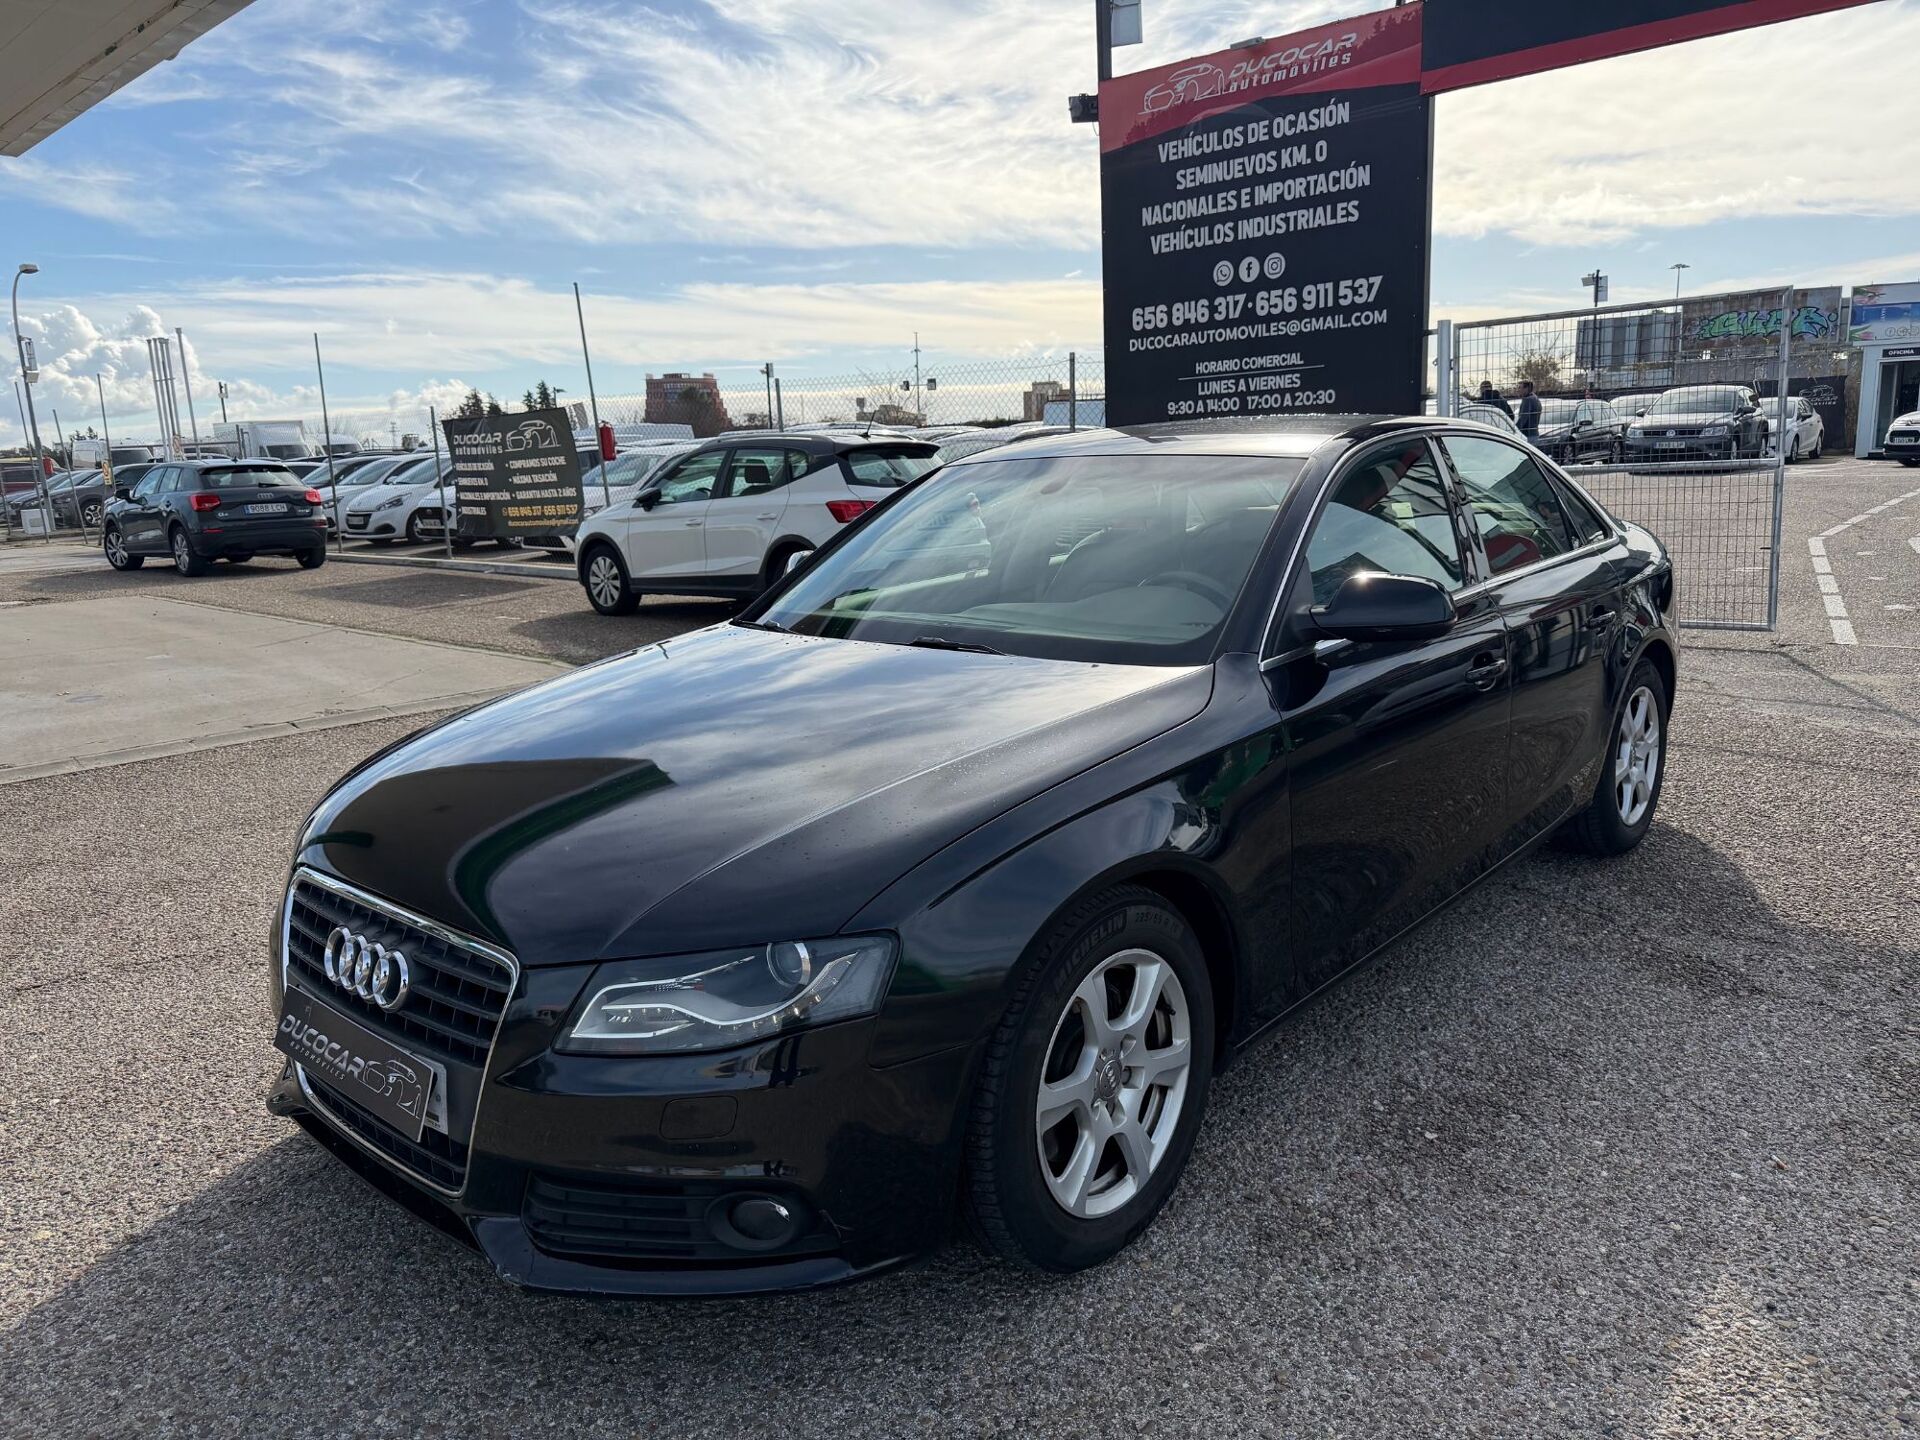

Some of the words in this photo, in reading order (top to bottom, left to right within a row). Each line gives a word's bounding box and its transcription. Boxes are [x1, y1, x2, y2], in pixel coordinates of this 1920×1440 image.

[1228, 32, 1357, 79] DUCOCAR
[1158, 124, 1244, 163] VEHÍCULOS
[1247, 122, 1270, 143] DE
[1272, 98, 1350, 136] OCASIÓN
[1176, 151, 1277, 190] SEMINUEVOS
[1281, 145, 1312, 170] KM.
[1141, 190, 1237, 227] NACIONALES
[1240, 187, 1251, 209] E
[1254, 161, 1371, 206] IMPORTACIÓN
[1150, 224, 1235, 255] VEHÍCULOS
[1237, 200, 1360, 241] INDUSTRIALES
[1132, 307, 1168, 331] 656
[1172, 302, 1210, 326] 846
[1302, 283, 1331, 311] 911
[1338, 275, 1384, 305] 537
[1129, 309, 1388, 351] DUCOCARAUTOMOVILES@GMAIL.COM
[1196, 358, 1241, 375] HORARIO
[1242, 352, 1304, 371] COMERCIAL
[1198, 379, 1236, 396] LUNES
[1237, 378, 1247, 392] A
[1249, 373, 1301, 391] VIERNES
[1167, 401, 1195, 416] 9:30
[1196, 399, 1205, 414] A
[1206, 397, 1240, 413] 14:00
[1247, 393, 1282, 410] 17:00
[1283, 391, 1292, 407] A
[1294, 389, 1336, 407] 20:30
[453, 432, 502, 445] DUCOCAR
[1054, 912, 1124, 990] MICHELIN
[279, 1014, 366, 1080] DUCOCAR
